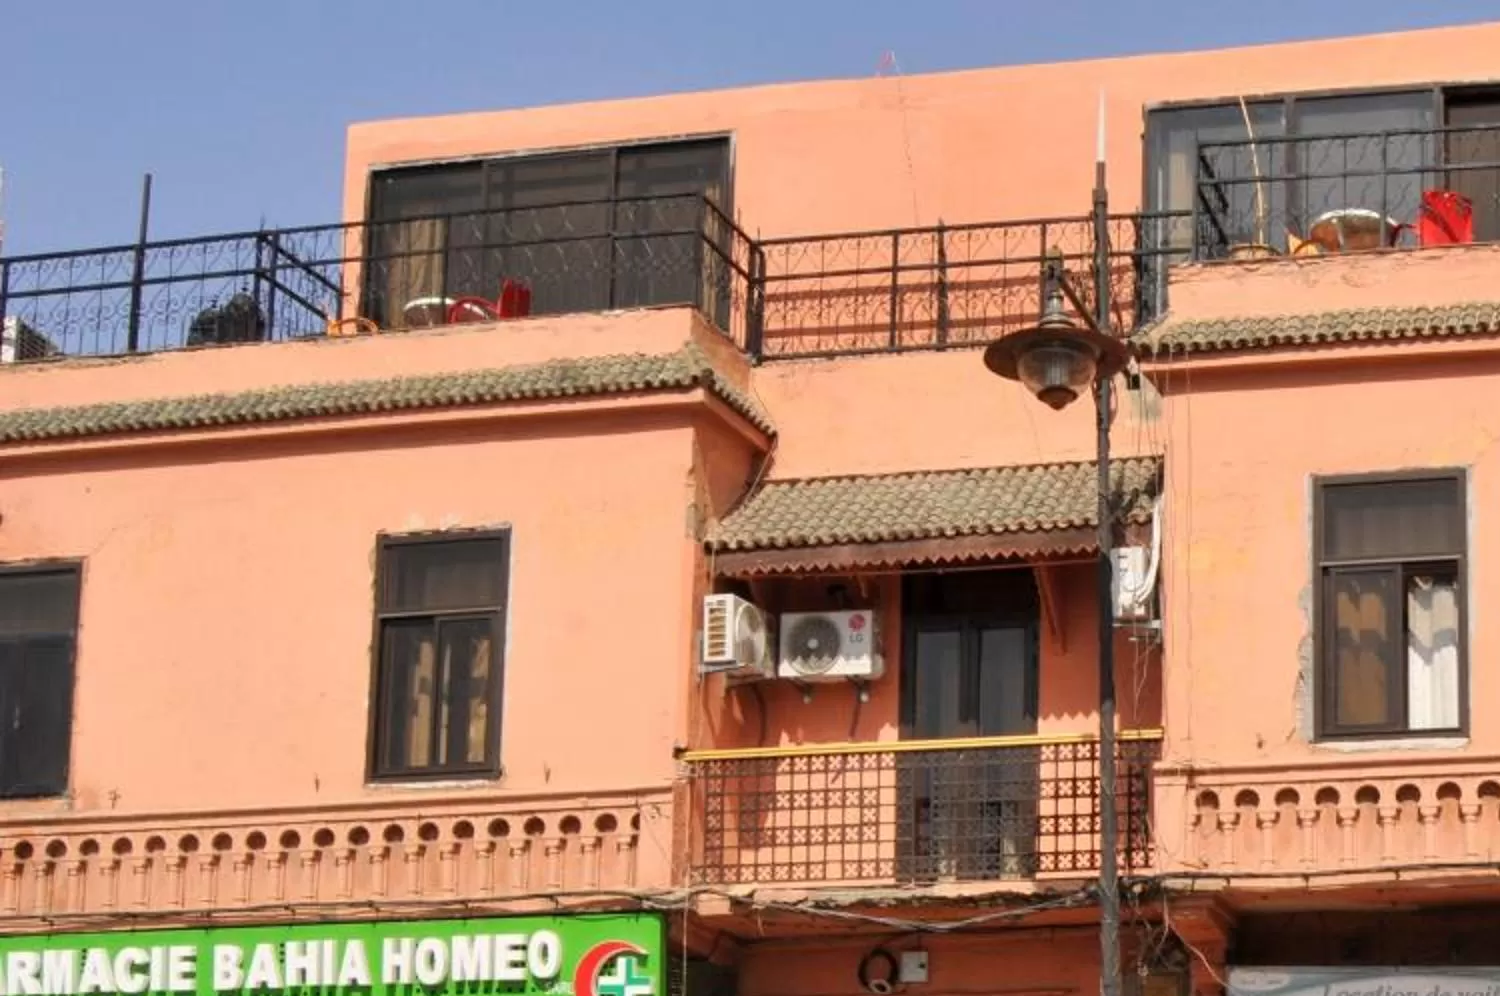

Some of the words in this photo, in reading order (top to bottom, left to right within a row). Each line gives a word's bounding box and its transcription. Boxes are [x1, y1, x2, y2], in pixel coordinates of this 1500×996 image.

[0, 945, 198, 996] RMACIE
[213, 937, 371, 992] BAHIA
[381, 929, 563, 987] HOMEO
